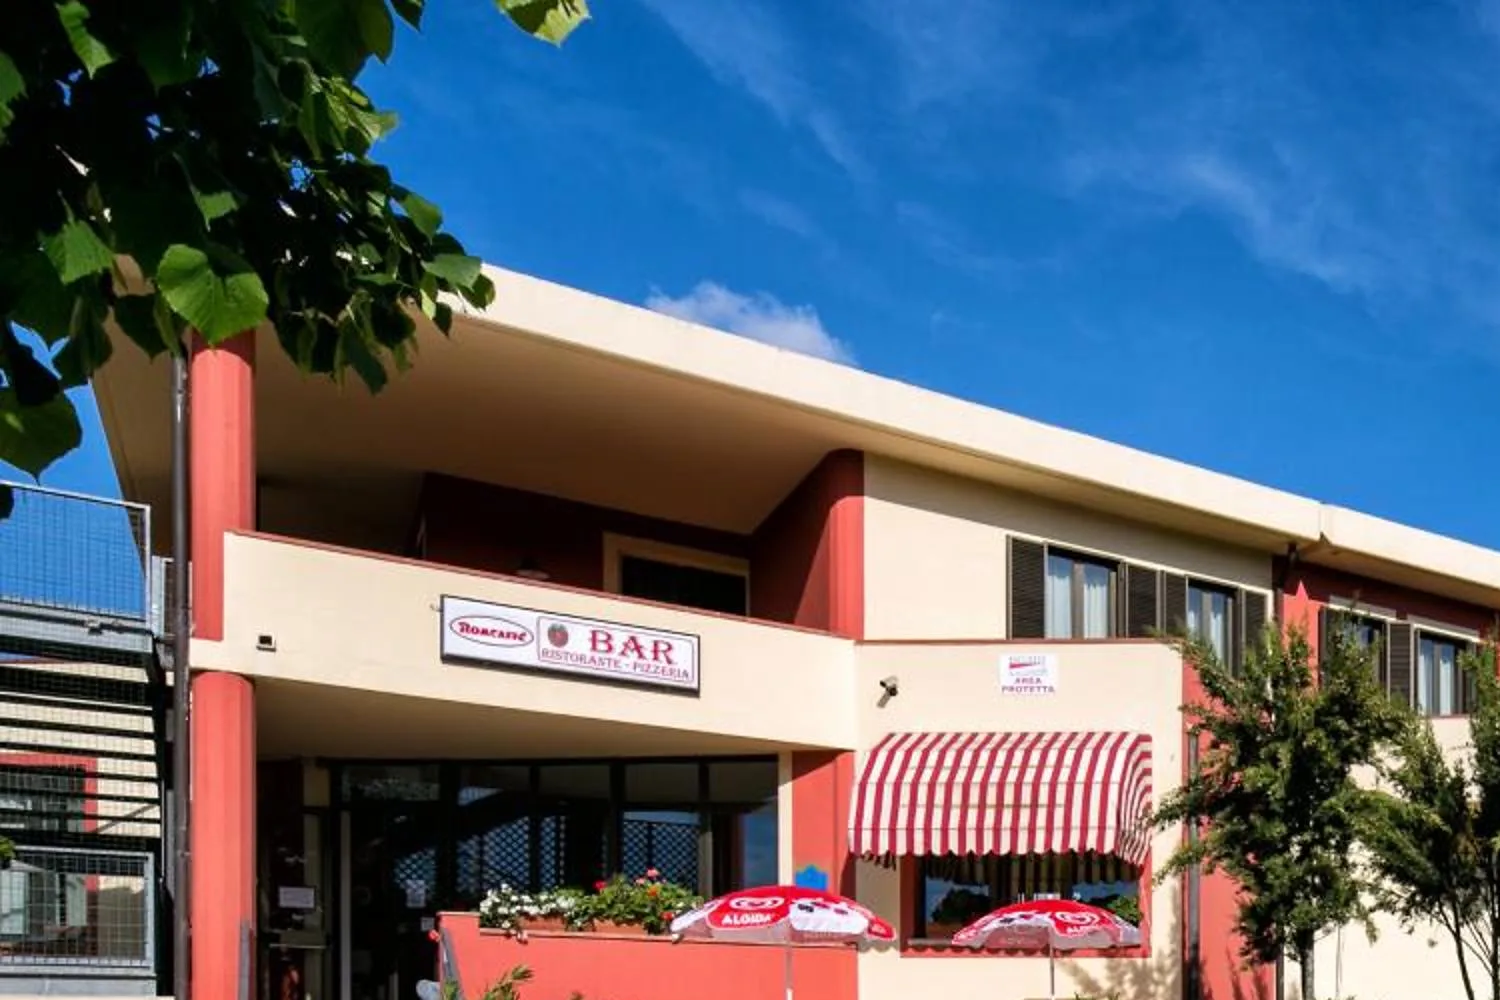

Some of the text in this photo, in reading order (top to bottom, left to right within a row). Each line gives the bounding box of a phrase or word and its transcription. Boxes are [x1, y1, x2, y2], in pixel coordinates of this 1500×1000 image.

[541, 647, 621, 668] RISTORANTE
[633, 661, 689, 679] PIZZERIA
[589, 629, 676, 665] BAR
[1001, 685, 1056, 693] PROTETTA
